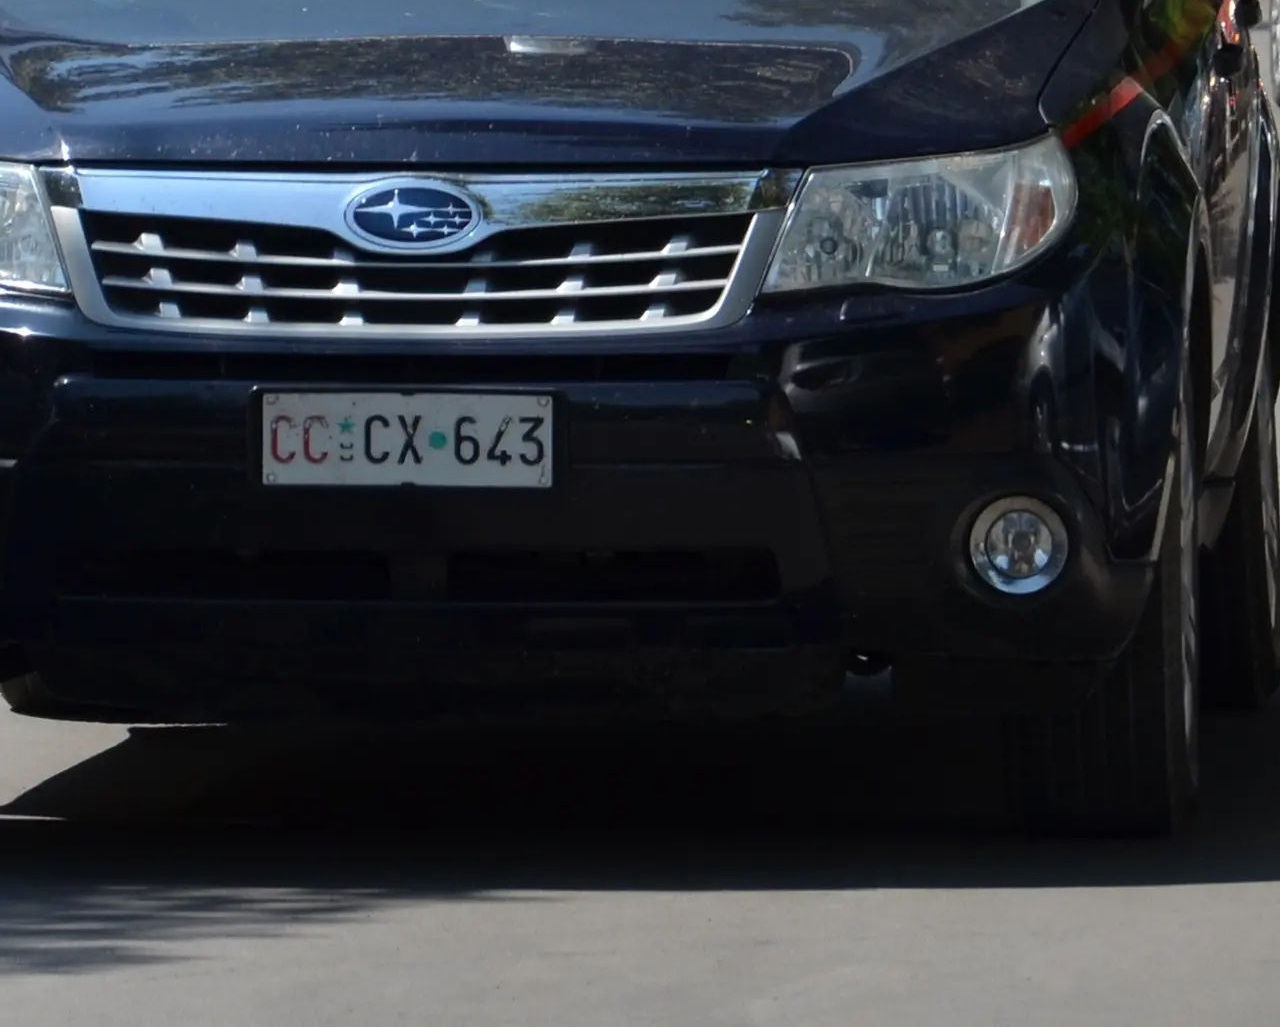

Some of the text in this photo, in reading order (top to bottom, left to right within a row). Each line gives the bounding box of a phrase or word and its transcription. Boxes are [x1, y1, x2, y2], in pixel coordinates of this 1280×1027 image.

[270, 414, 545, 466] CC CX 643
